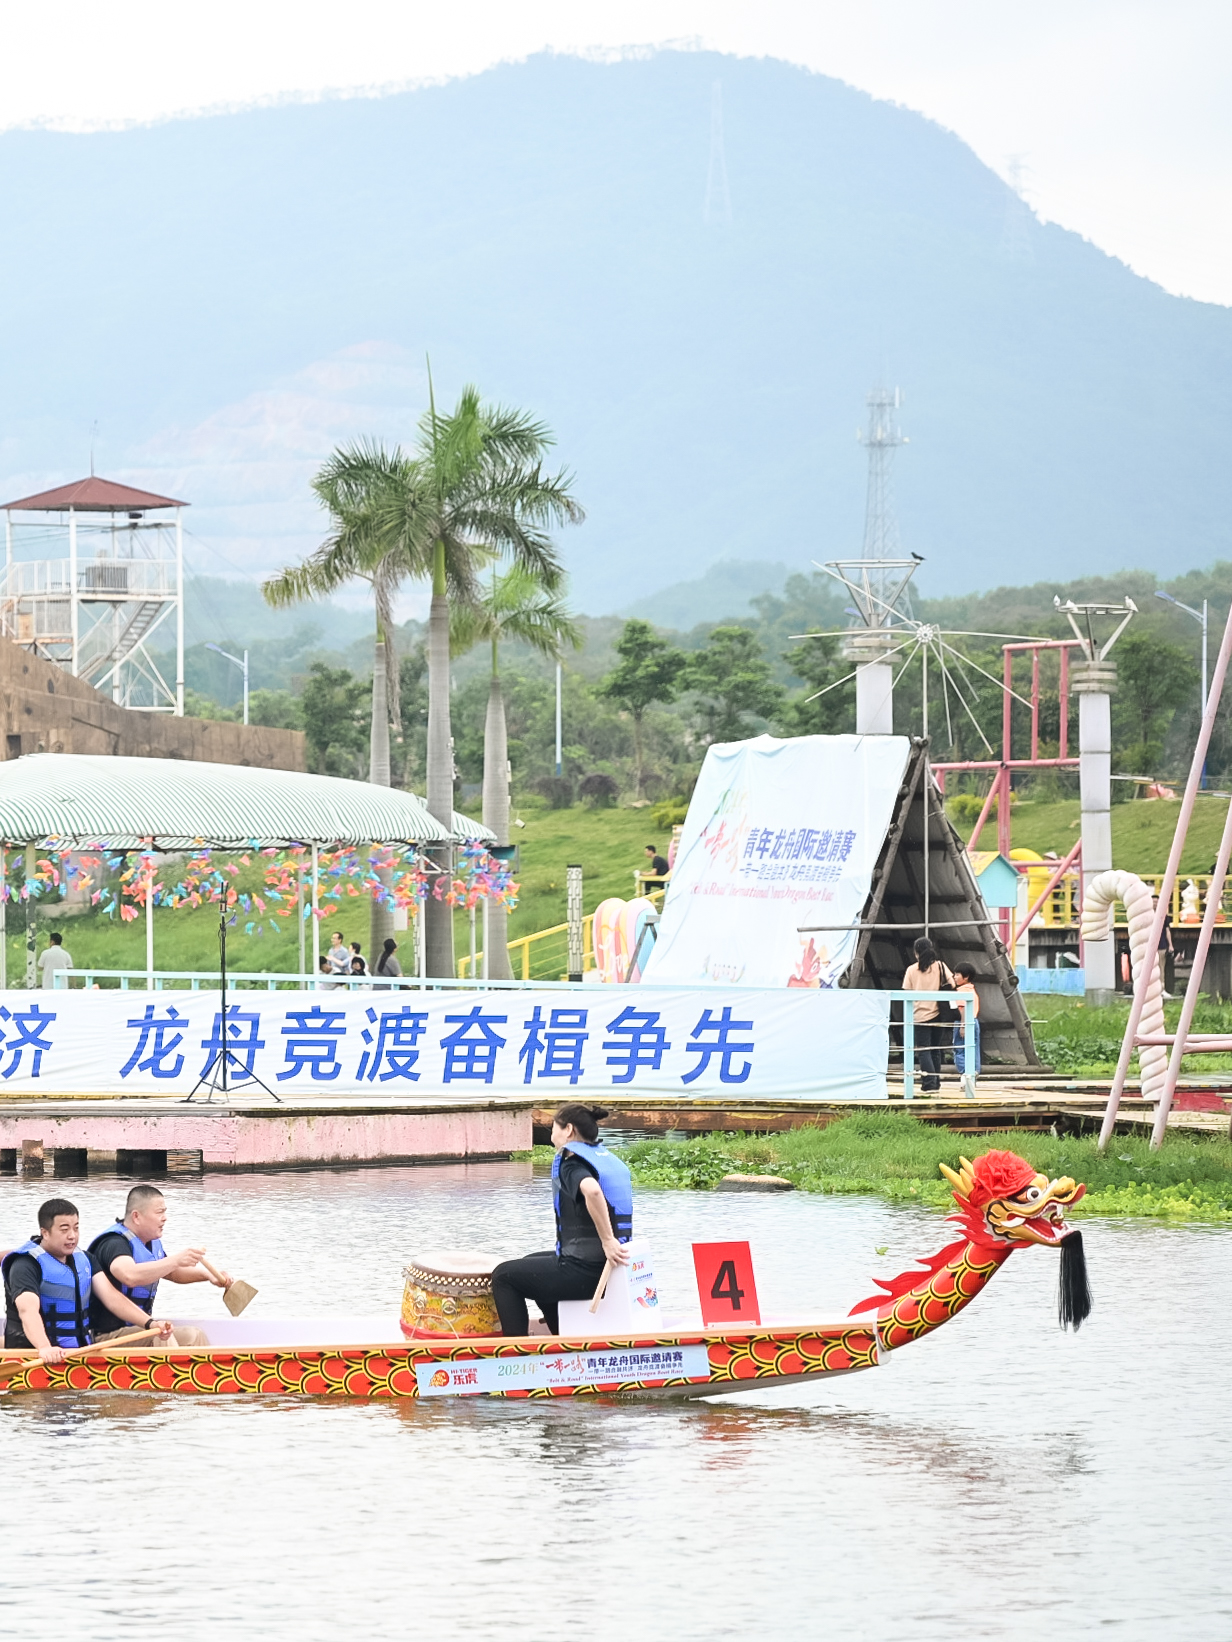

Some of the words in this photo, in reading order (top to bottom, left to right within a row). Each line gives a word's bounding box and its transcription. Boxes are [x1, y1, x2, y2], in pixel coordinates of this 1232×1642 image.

[119, 1004, 755, 1085] 龙舟竞渡奋楫争先
[711, 1260, 745, 1311] 4
[453, 1373, 478, 1385] 乐虎
[497, 1362, 539, 1377] 2024年
[587, 1351, 683, 1369] 青年龙舟国际邀请赛
